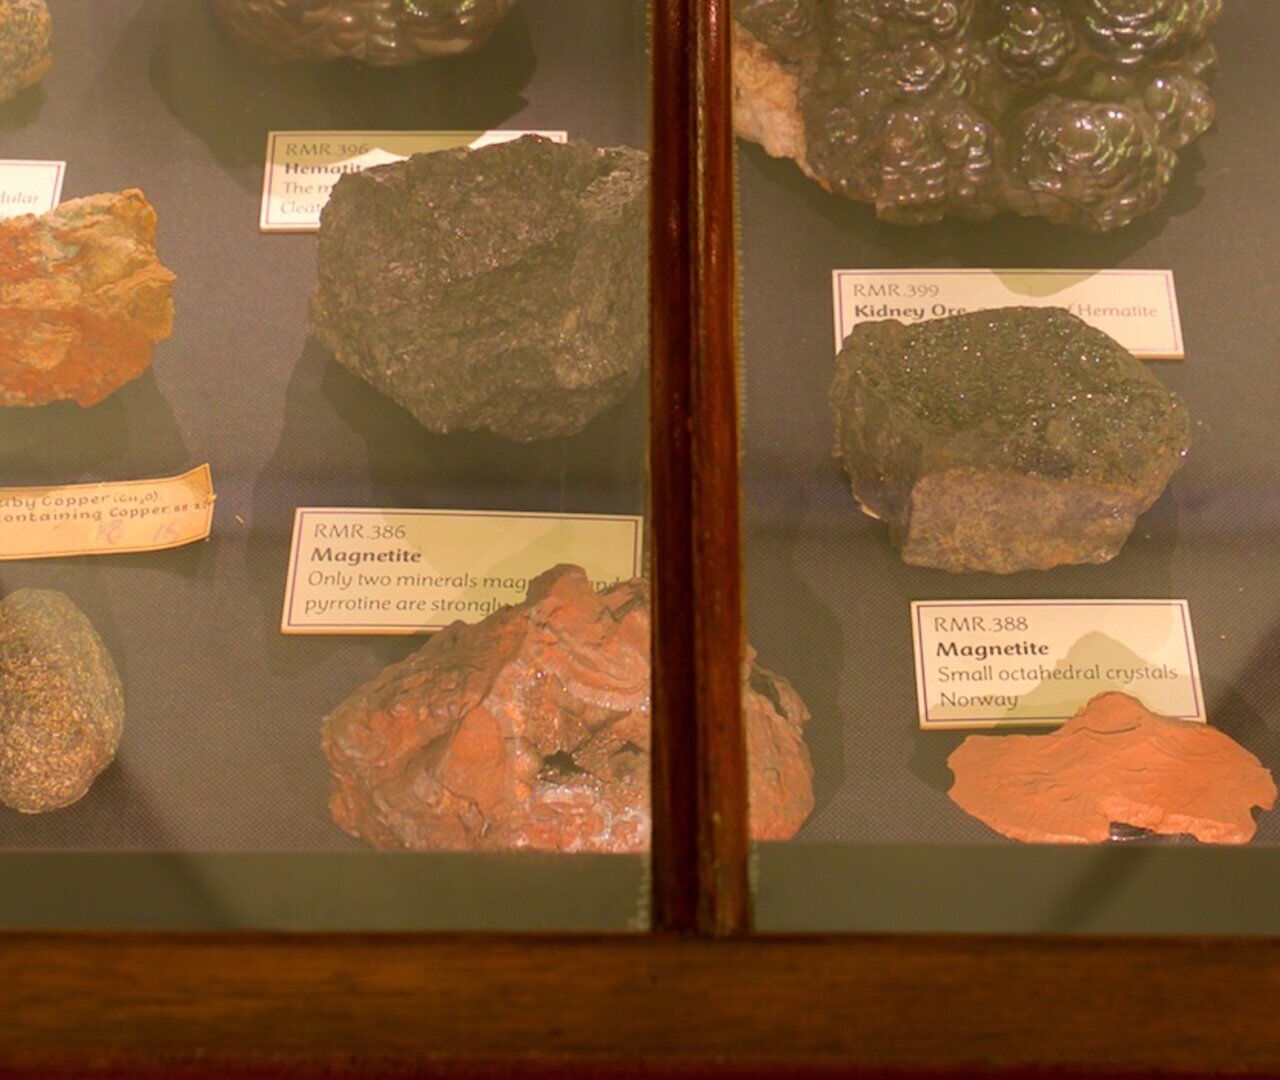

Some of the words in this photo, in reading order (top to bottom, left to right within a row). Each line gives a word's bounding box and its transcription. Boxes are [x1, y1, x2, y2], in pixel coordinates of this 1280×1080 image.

[284, 162, 368, 176] Hematit
[283, 182, 314, 195] The
[854, 304, 925, 320] Kidney
[931, 304, 967, 317] Ore
[1078, 304, 1158, 318] Hematite
[42, 494, 111, 507] Copper
[109, 507, 169, 519] Copper
[314, 523, 406, 540] RMR.386
[310, 548, 422, 564] Magnetite
[307, 571, 353, 590] Only
[358, 573, 392, 588] two
[396, 572, 478, 589] minerals
[304, 597, 392, 615] pyrrotine
[396, 598, 427, 612] are
[934, 616, 1029, 633] RMR.388
[936, 641, 1050, 661] Magnetite
[938, 666, 993, 683] Small
[999, 665, 1101, 682] octahedral
[1106, 665, 1178, 684] crystals
[940, 692, 1019, 710] Norway
